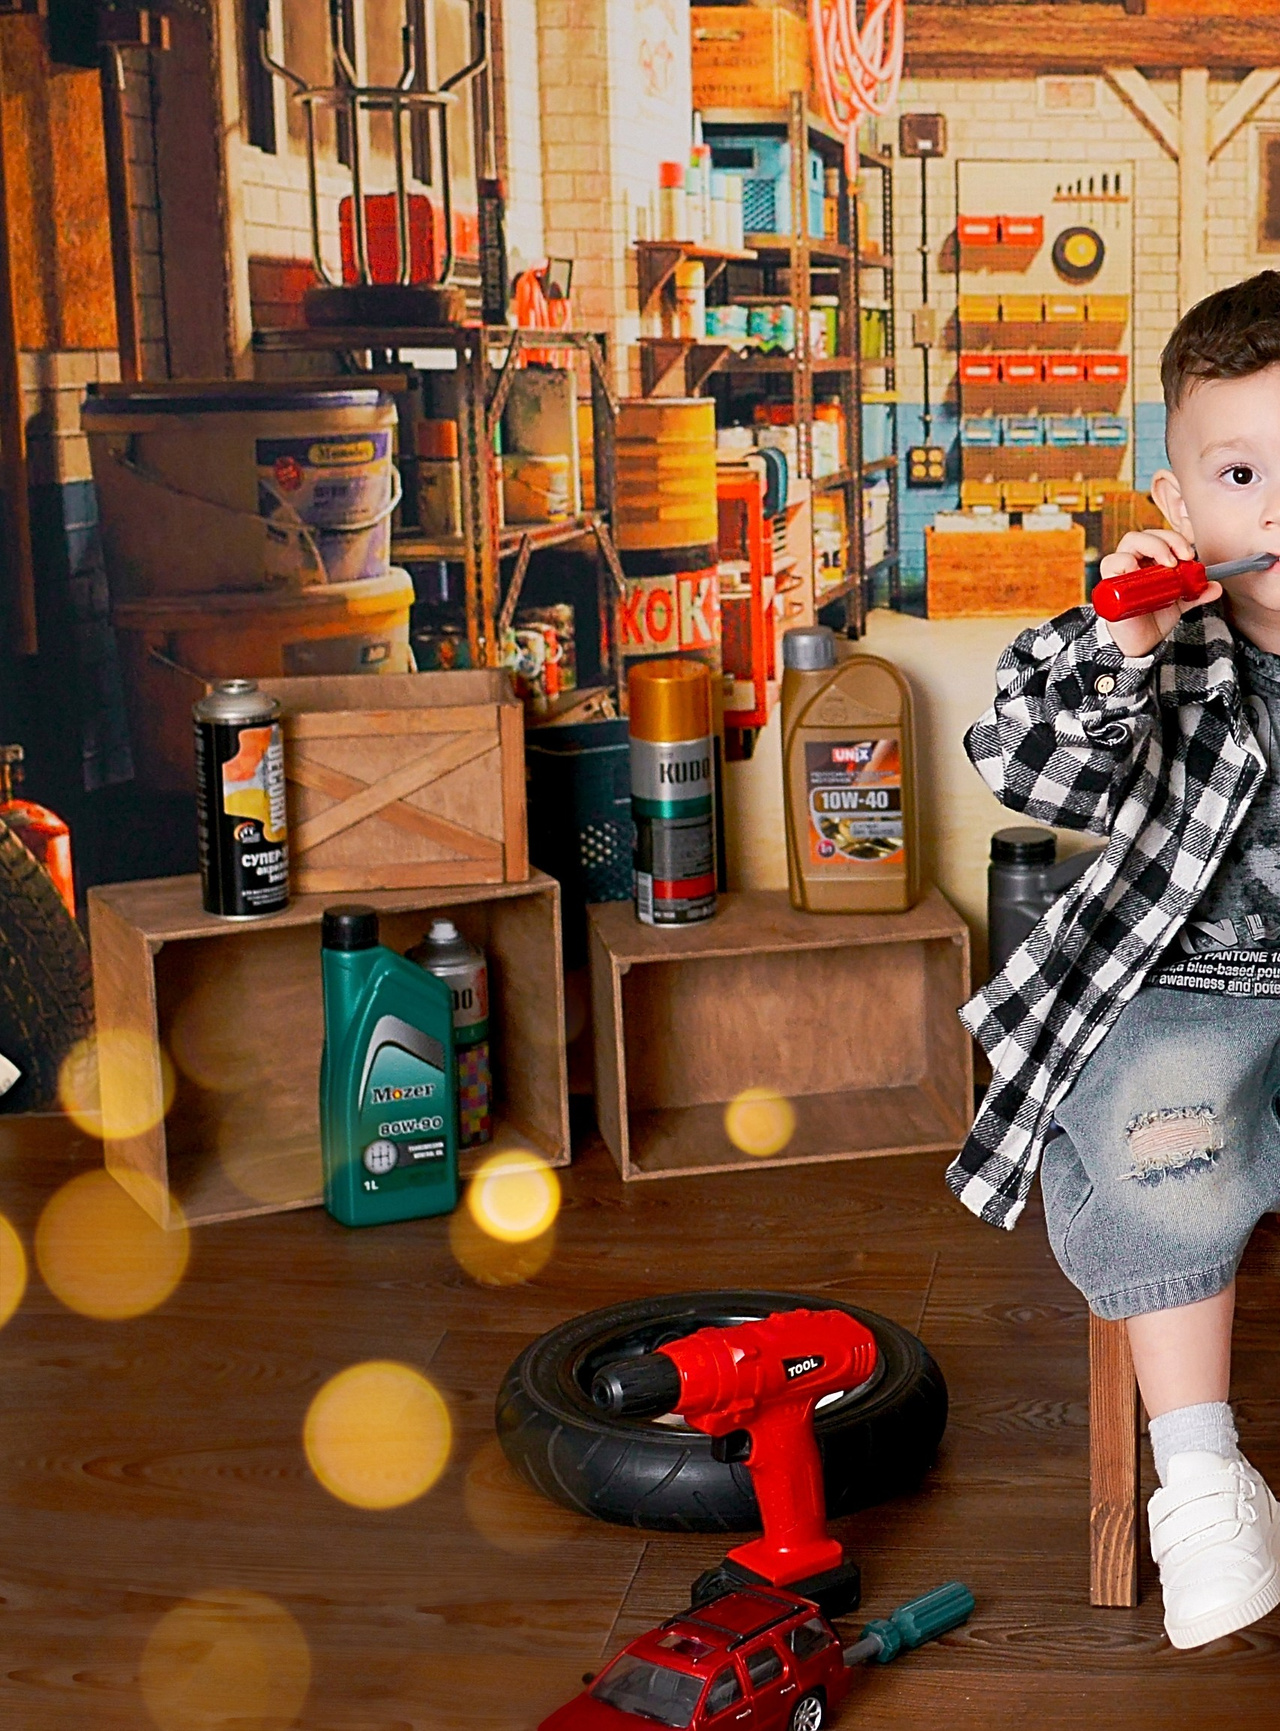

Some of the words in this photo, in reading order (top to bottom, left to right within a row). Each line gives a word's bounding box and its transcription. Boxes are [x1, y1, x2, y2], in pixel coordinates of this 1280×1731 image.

[660, 758, 711, 784] KUDO
[821, 790, 890, 809] 10W-40
[1204, 951, 1269, 963] PANTONE
[1186, 962, 1255, 977] blue-based
[1159, 974, 1225, 991] awareness
[1227, 980, 1251, 993] and
[371, 1083, 436, 1105] Mozer
[378, 1115, 444, 1137] 80W-90
[787, 1358, 819, 1378] TOOL
